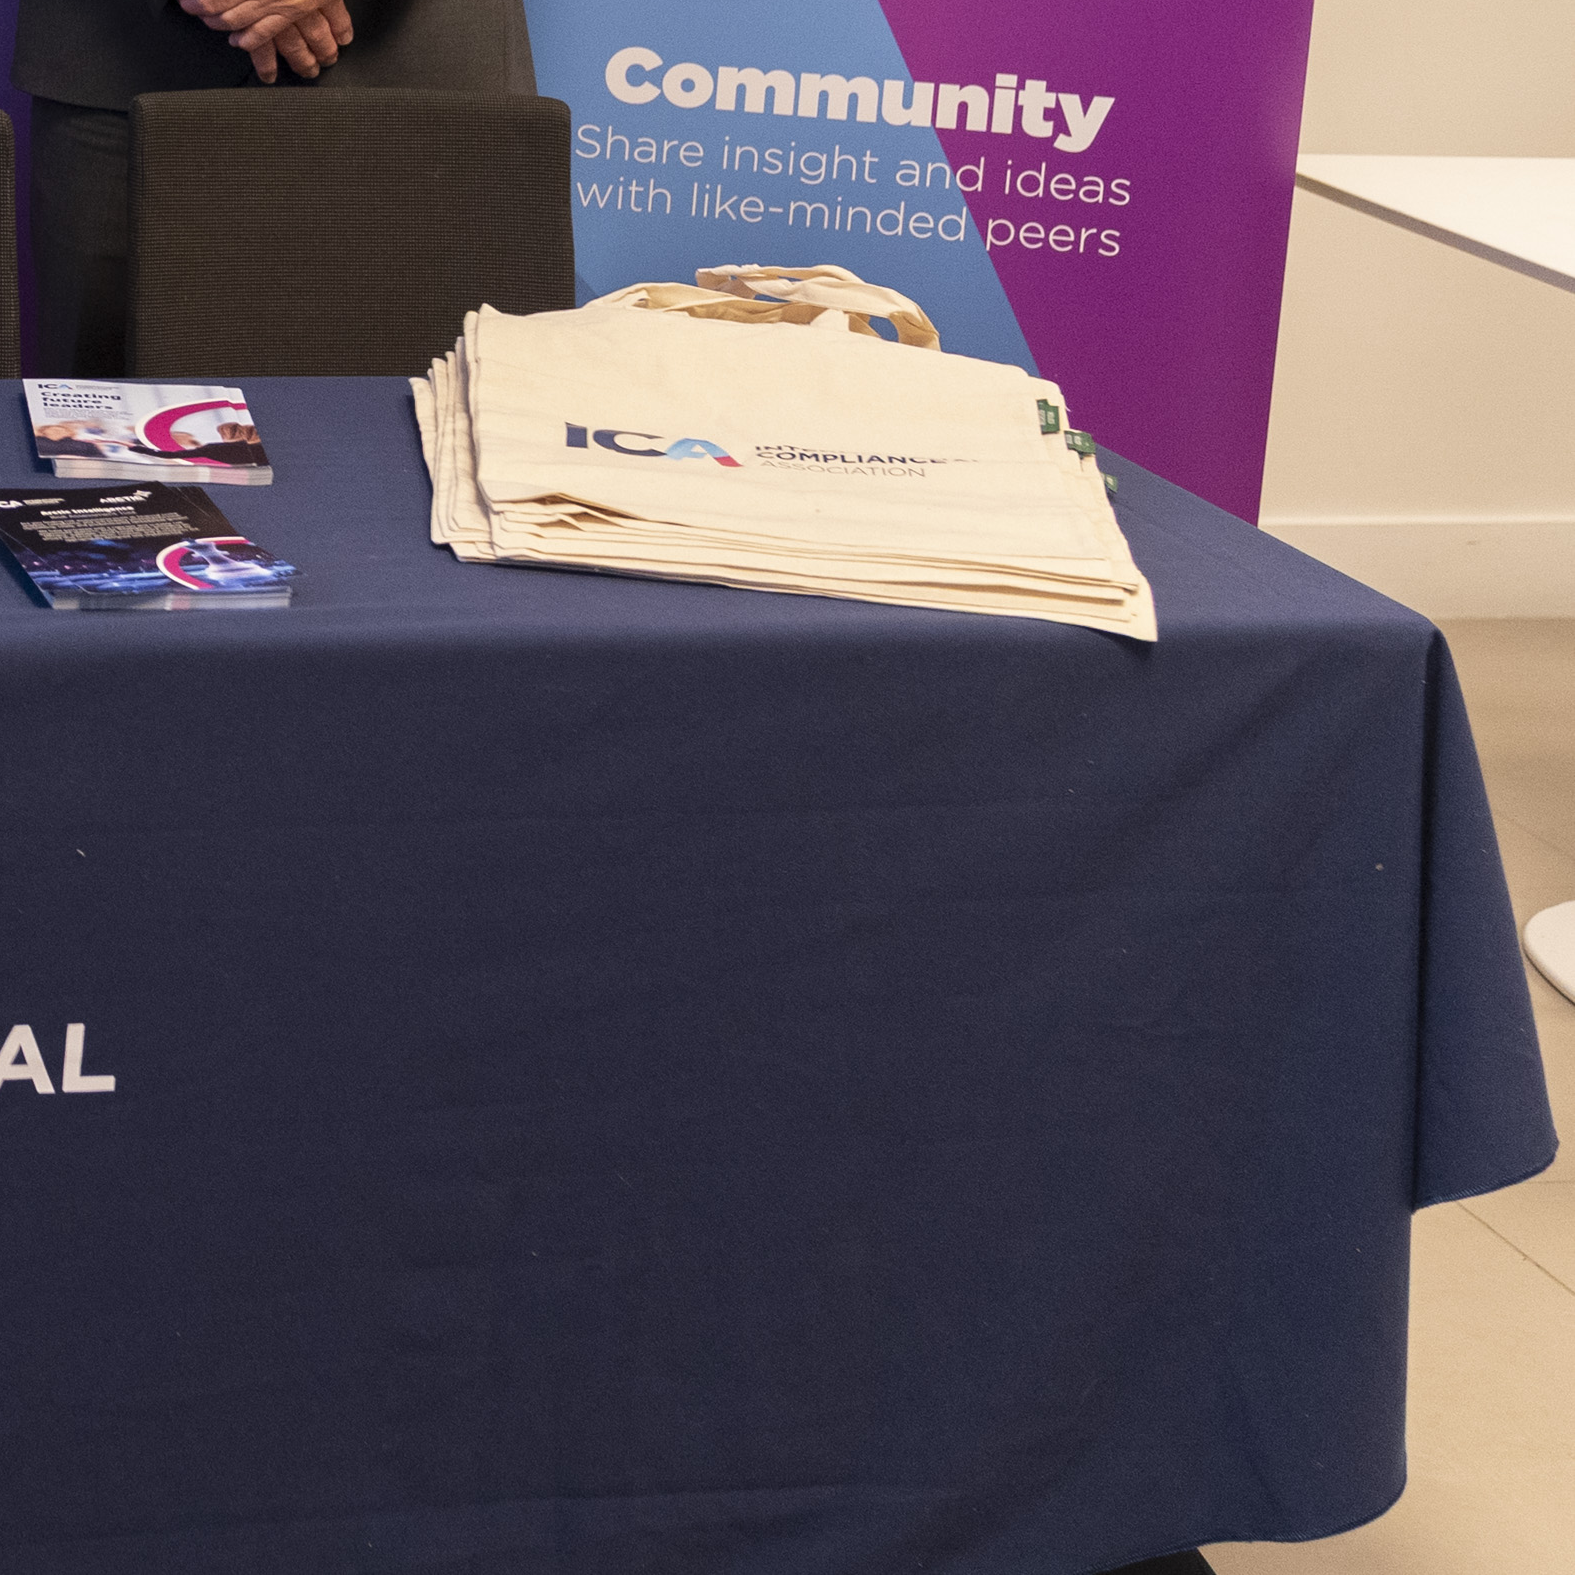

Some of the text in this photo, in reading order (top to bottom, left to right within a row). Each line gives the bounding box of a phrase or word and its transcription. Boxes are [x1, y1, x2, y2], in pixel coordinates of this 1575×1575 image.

[604, 46, 1115, 154] Community
[575, 123, 1131, 206] Share insight and ideas
[575, 177, 1122, 257] with like-minded peers
[41, 391, 121, 400] Creating
[43, 402, 113, 410] leaders
[565, 421, 744, 468] ICA
[760, 460, 927, 477] ASSOCIATION
